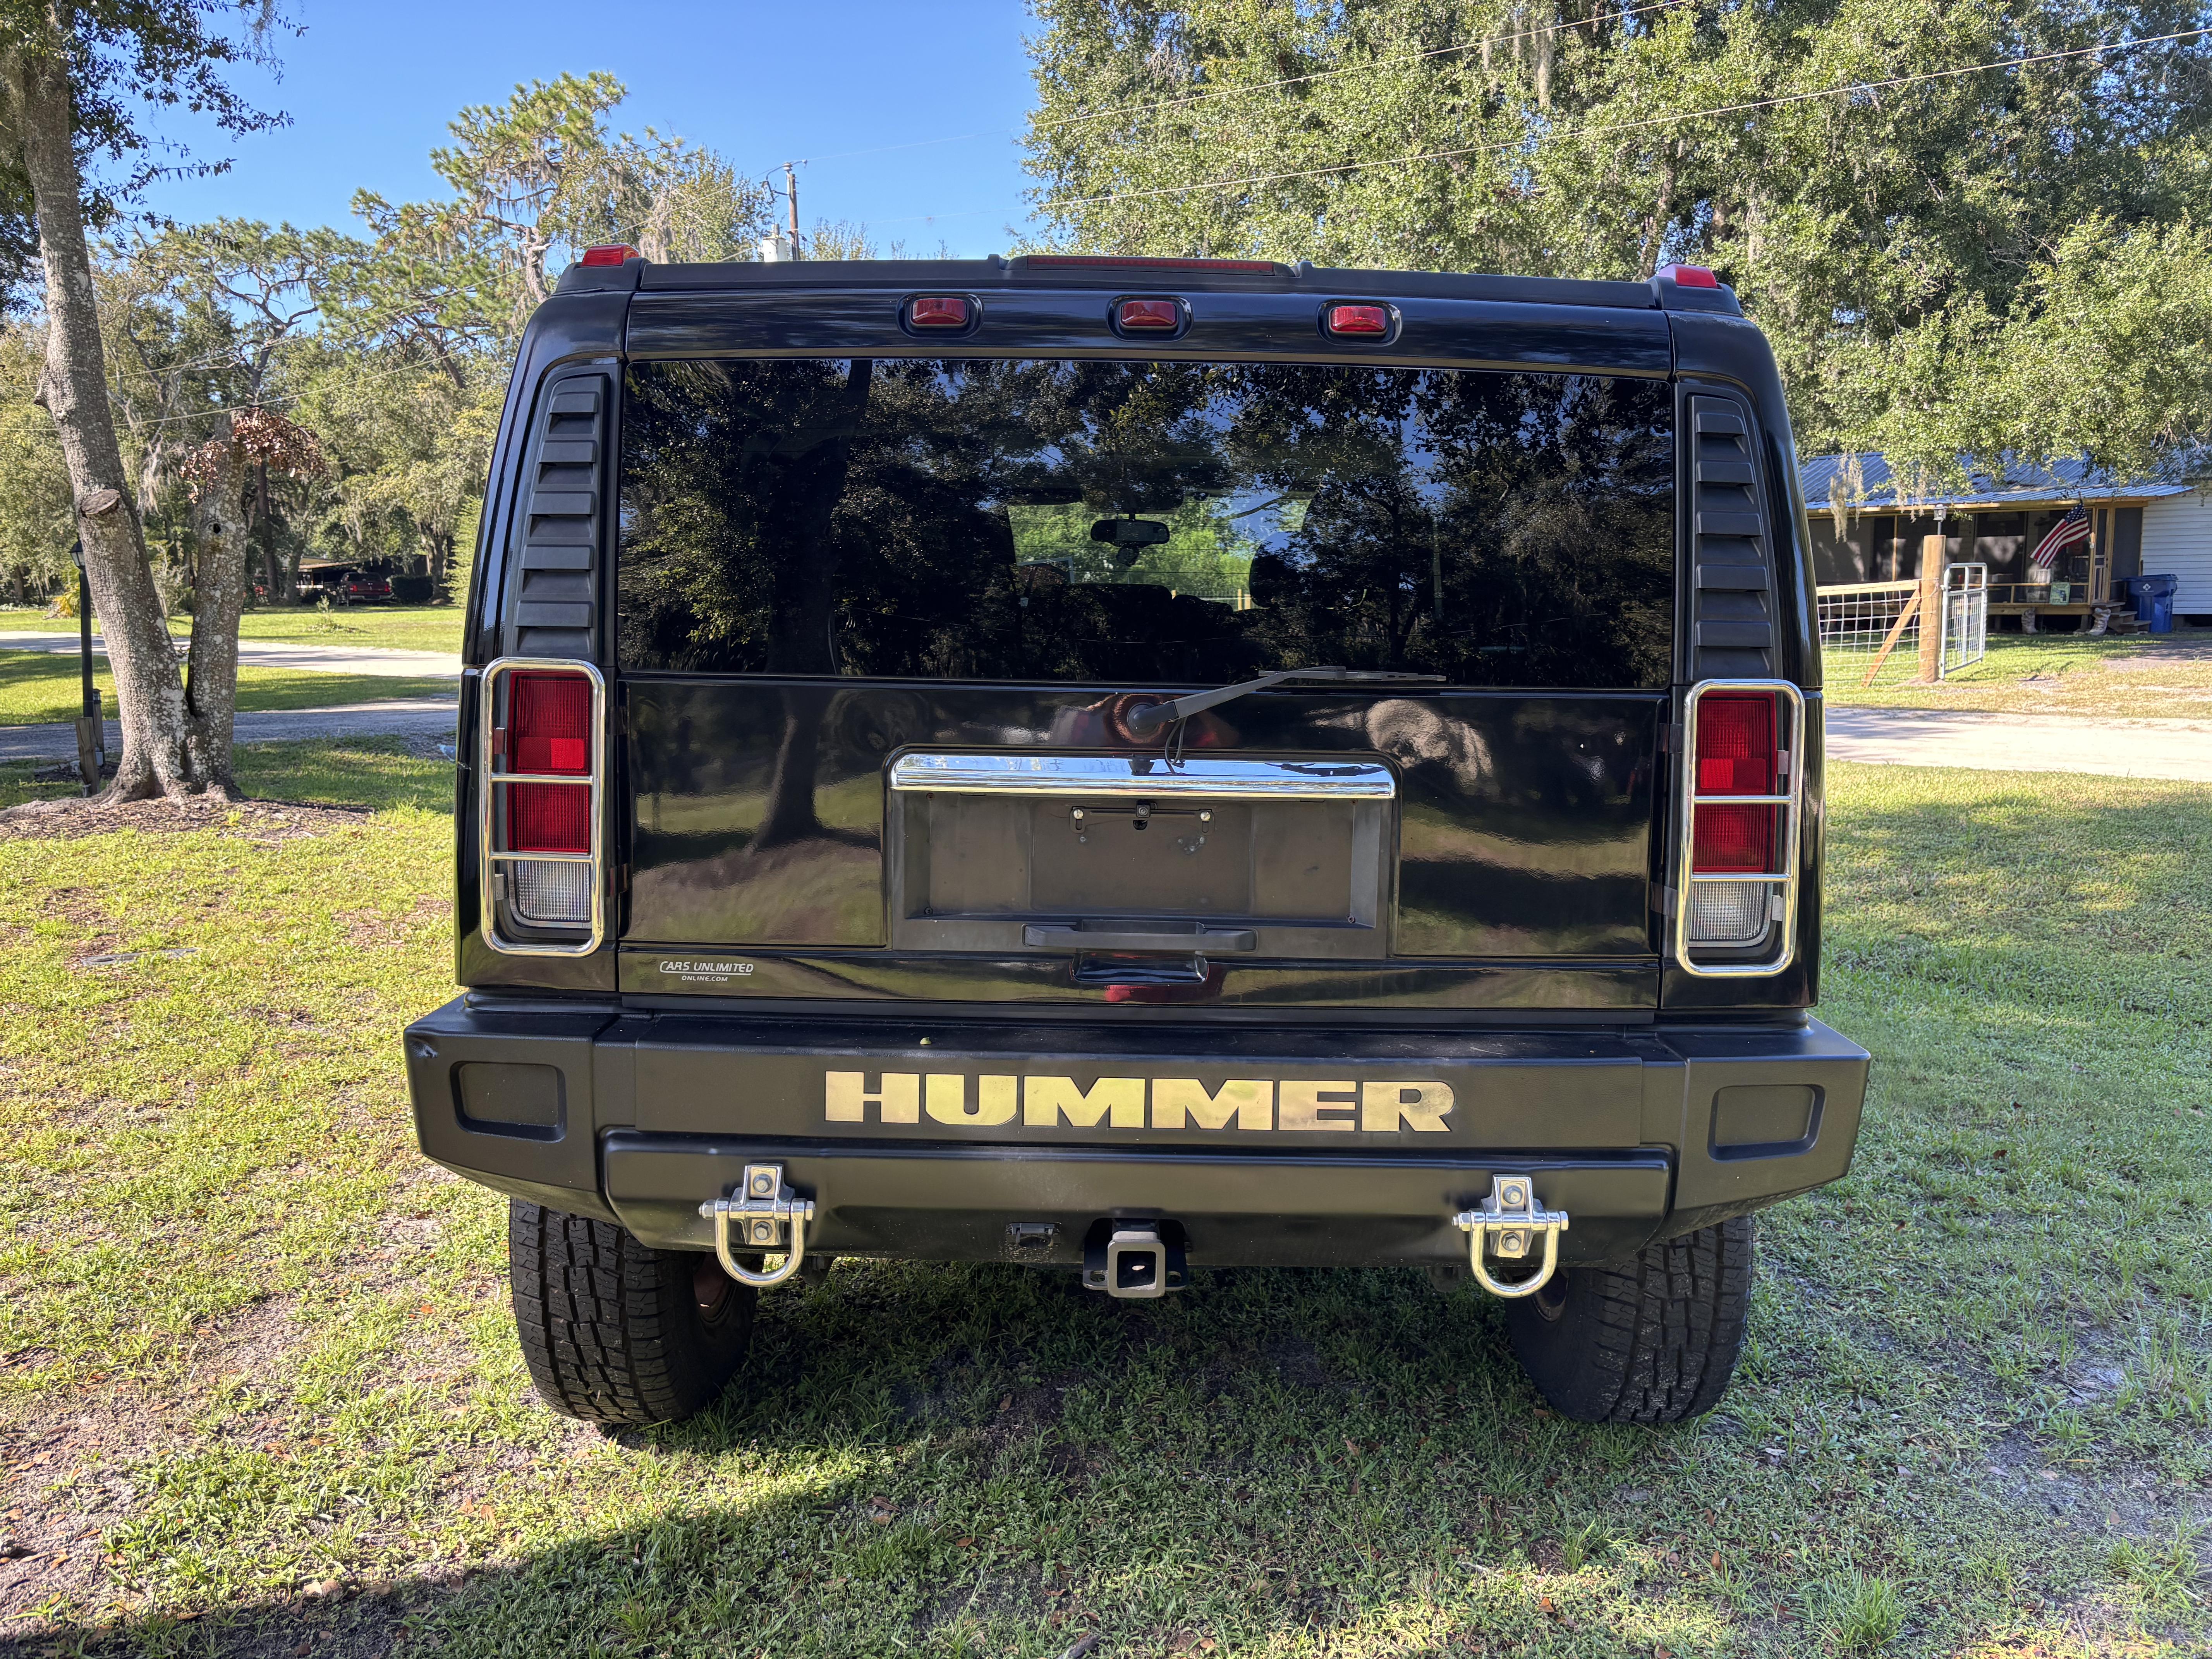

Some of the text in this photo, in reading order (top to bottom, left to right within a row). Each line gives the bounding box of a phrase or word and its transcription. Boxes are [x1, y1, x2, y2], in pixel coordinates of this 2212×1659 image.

[659, 961, 754, 972] CARS UNLIMITED
[825, 1070, 1455, 1132] HUMMER
